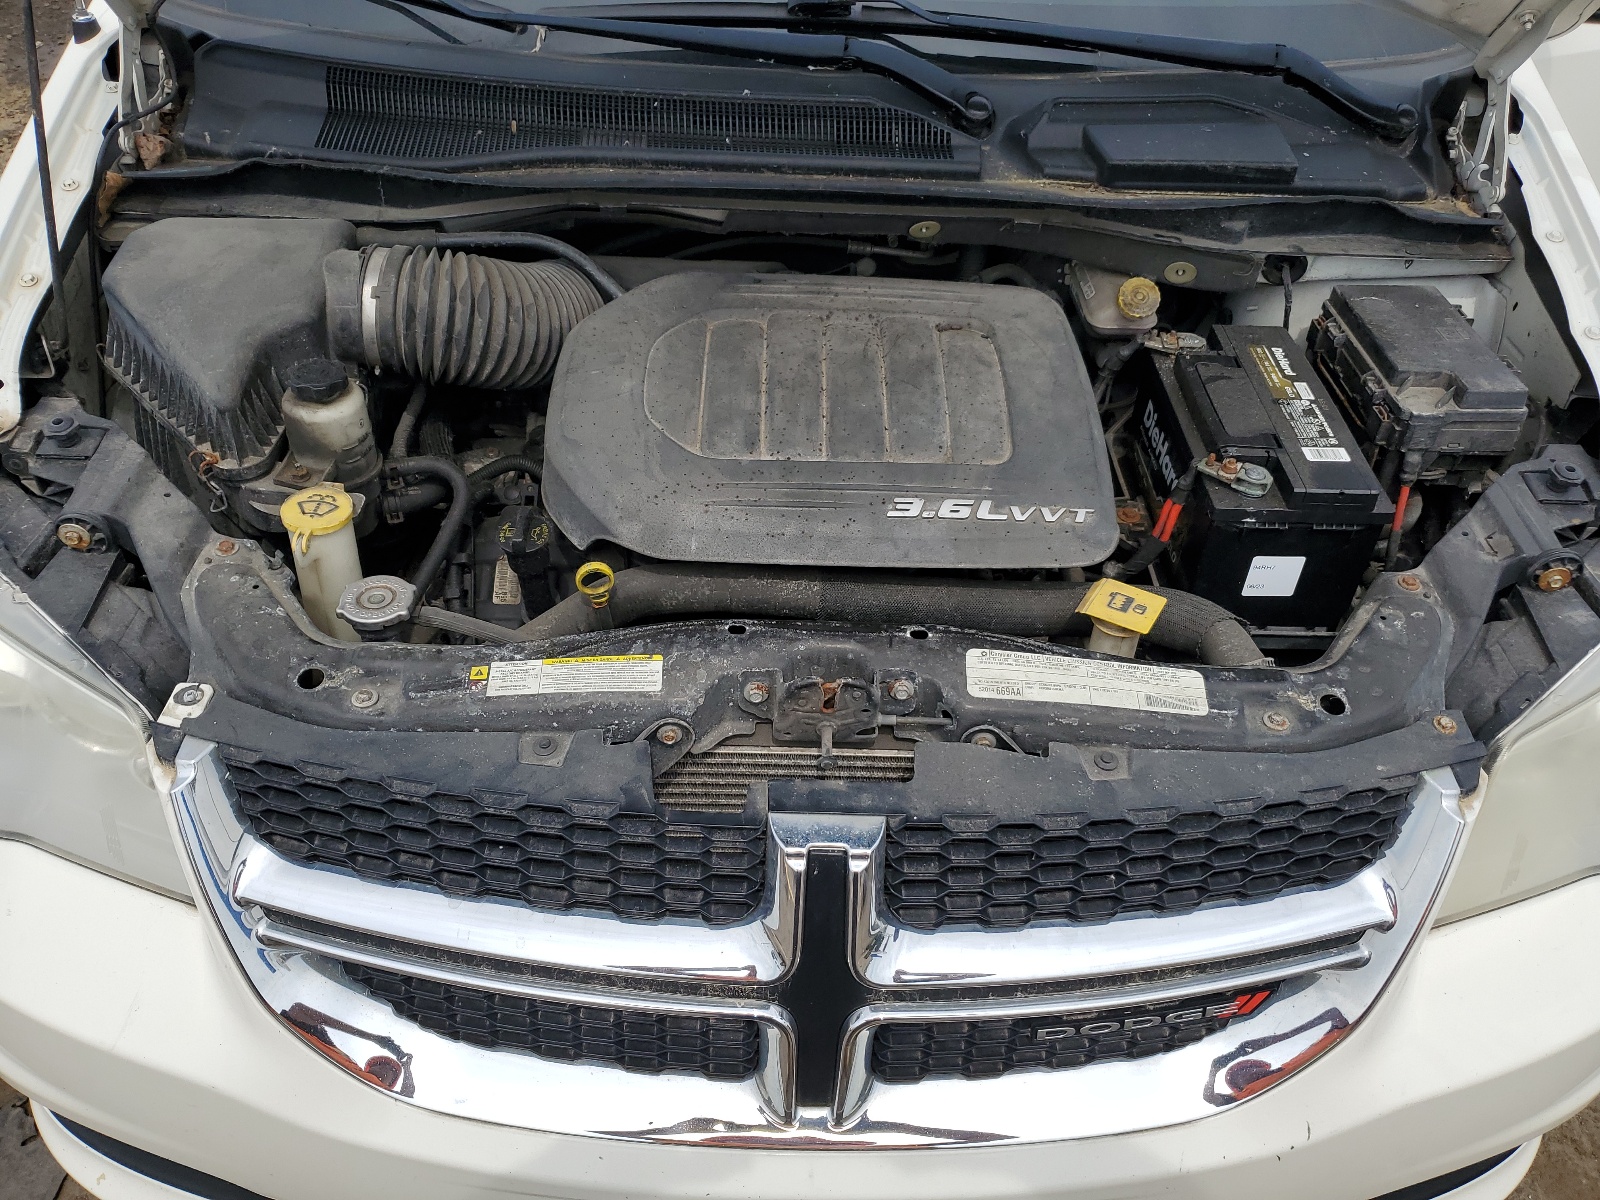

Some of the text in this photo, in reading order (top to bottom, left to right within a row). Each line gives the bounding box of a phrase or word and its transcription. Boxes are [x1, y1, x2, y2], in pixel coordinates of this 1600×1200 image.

[1271, 347, 1297, 376] DieHard
[1143, 398, 1179, 491] DieHar
[996, 686, 1022, 697] 669AA
[1035, 1001, 1240, 1041] DODGE
